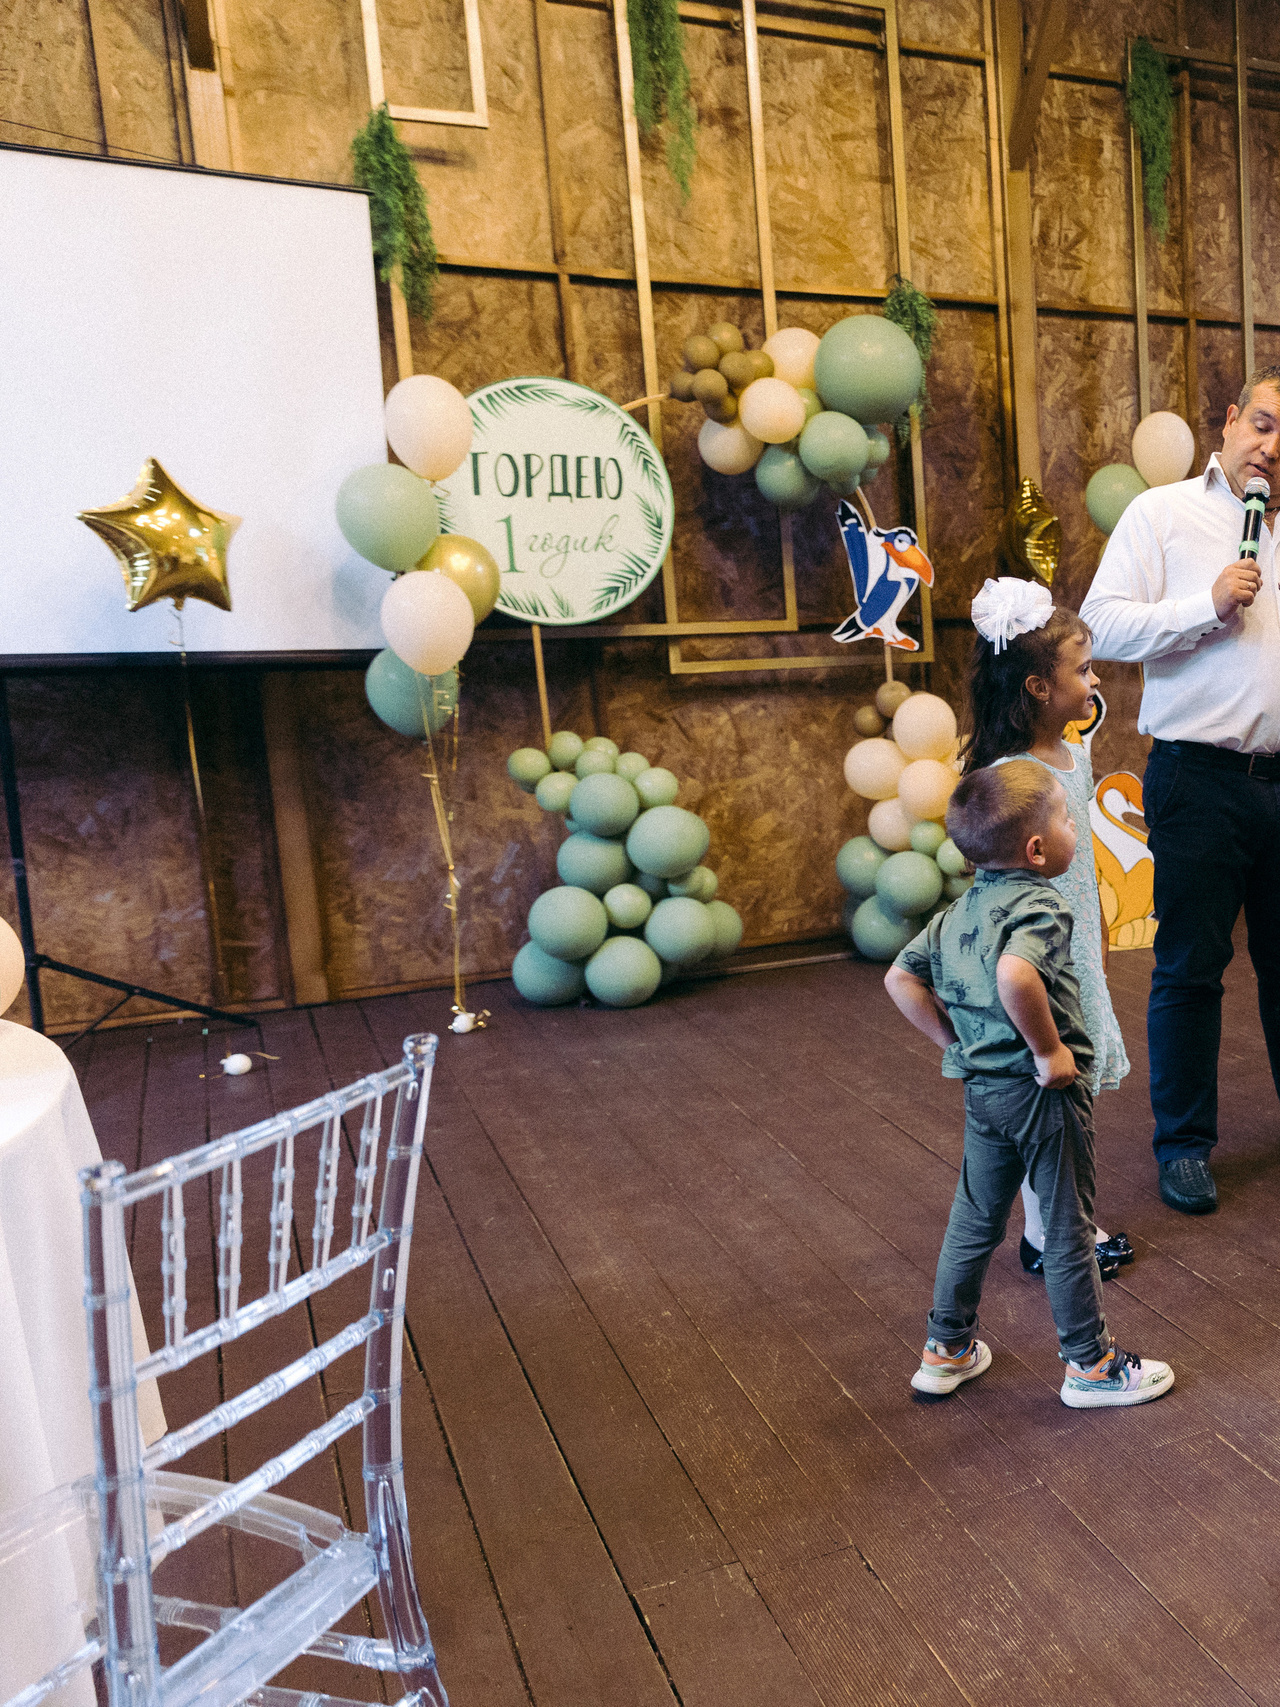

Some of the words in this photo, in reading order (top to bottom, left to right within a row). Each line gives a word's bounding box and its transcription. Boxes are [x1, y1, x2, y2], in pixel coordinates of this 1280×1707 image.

[470, 451, 623, 503] ГОРДЕЮ
[494, 514, 526, 574] 1
[526, 514, 620, 578] годик
